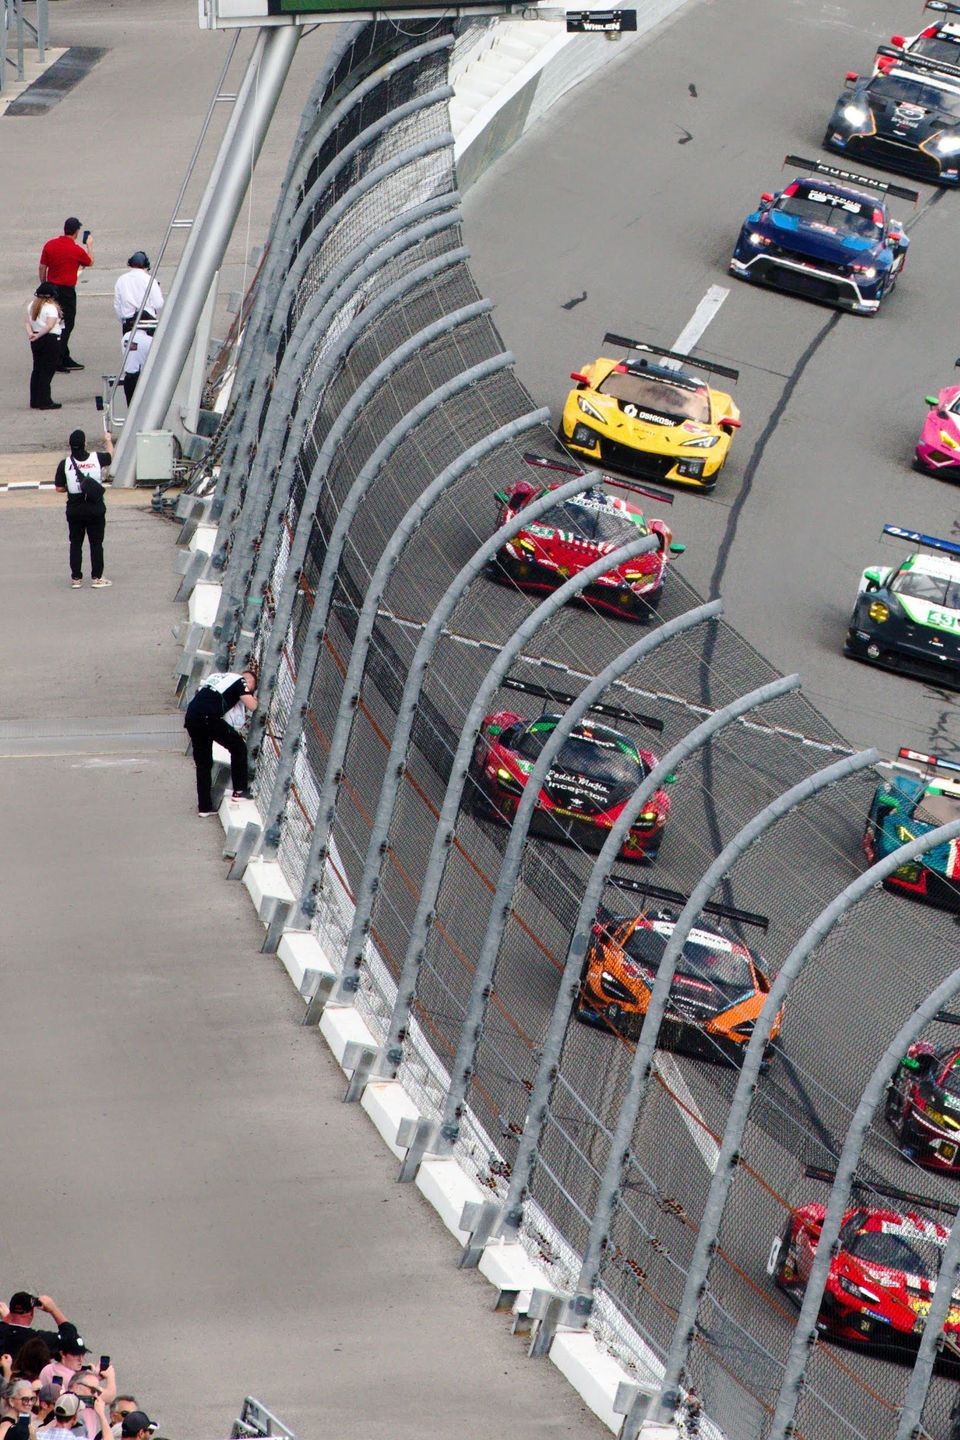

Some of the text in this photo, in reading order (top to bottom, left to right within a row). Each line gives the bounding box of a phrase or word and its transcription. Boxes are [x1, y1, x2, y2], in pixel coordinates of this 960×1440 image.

[584, 22, 620, 30] WHELEN
[818, 165, 888, 188] MUSTANG
[639, 411, 674, 427] OSHKOSH
[930, 610, 954, 626] 43
[549, 770, 577, 783] Pedal
[548, 781, 608, 804] inception
